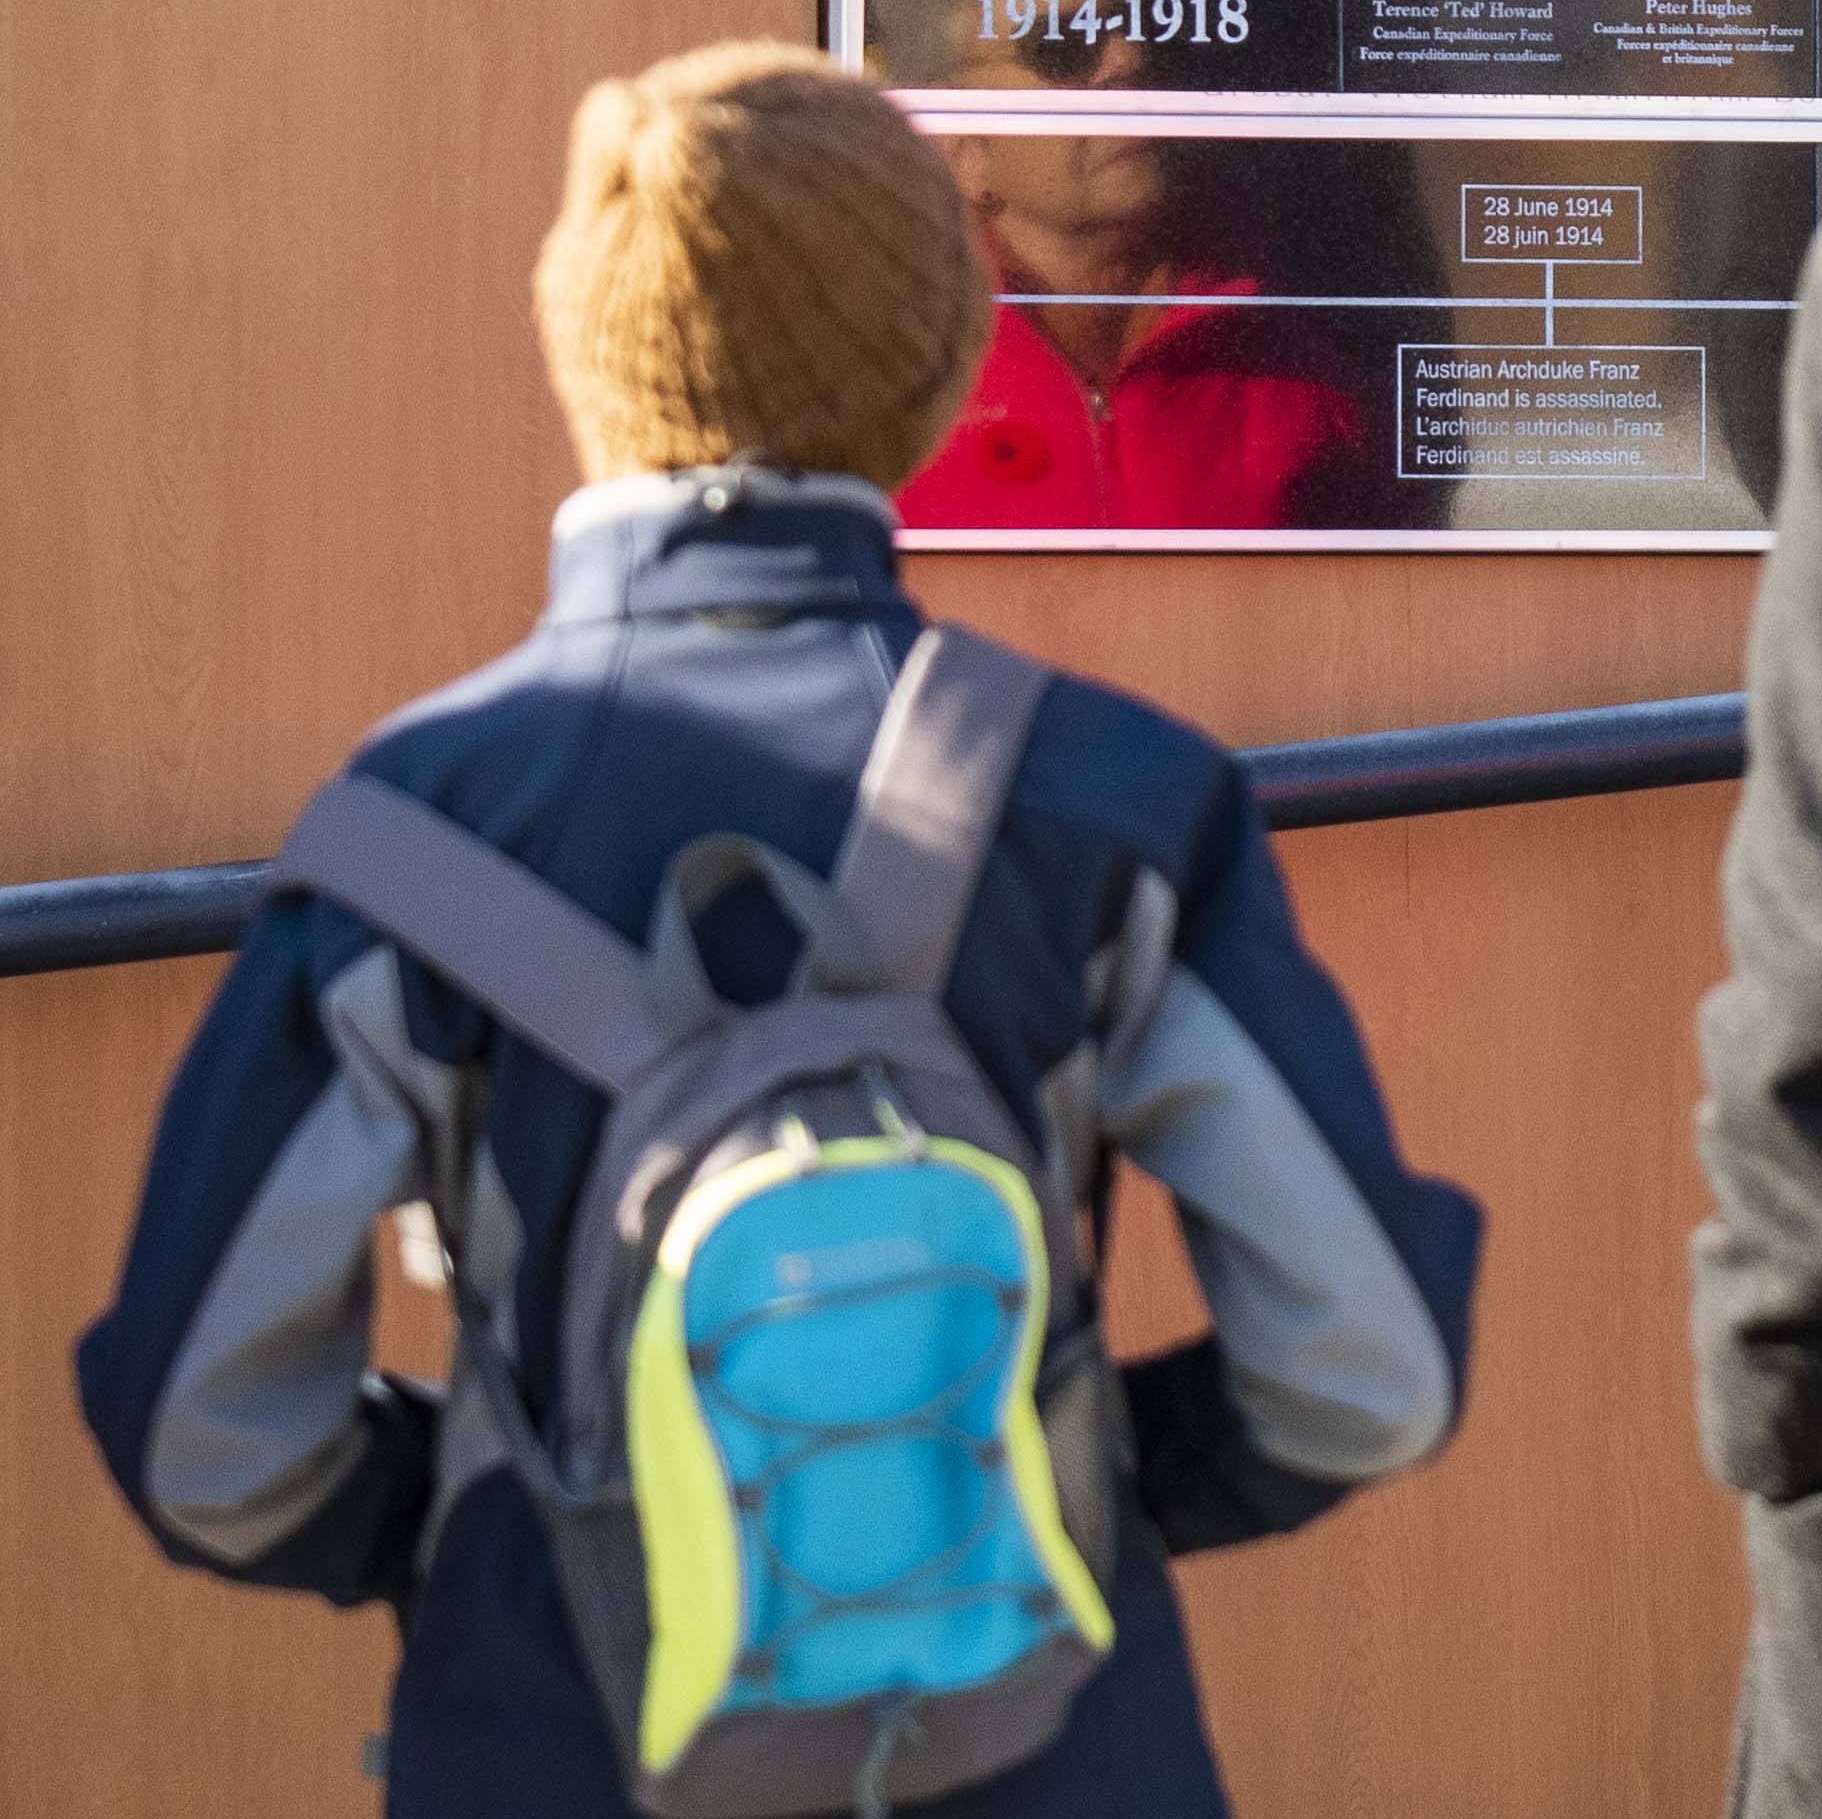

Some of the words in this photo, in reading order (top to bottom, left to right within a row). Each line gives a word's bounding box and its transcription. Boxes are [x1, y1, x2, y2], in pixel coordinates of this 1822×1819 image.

[1484, 196, 1510, 216] 28
[1514, 197, 1558, 216] June
[1565, 197, 1613, 217] 1914
[1484, 225, 1509, 244] 28
[1512, 225, 1548, 249] juin
[1555, 225, 1604, 245] 1914
[1415, 358, 1492, 379] Austrian
[1497, 359, 1584, 379] Archduke
[1589, 360, 1639, 380] Franz
[1416, 387, 1509, 408] Ferdinand
[1515, 388, 1530, 407] is
[1535, 389, 1661, 409] assassinated.
[1416, 444, 1508, 465] Ferdinand
[1515, 449, 1544, 465] est
[1549, 446, 1645, 465] assassiné.
